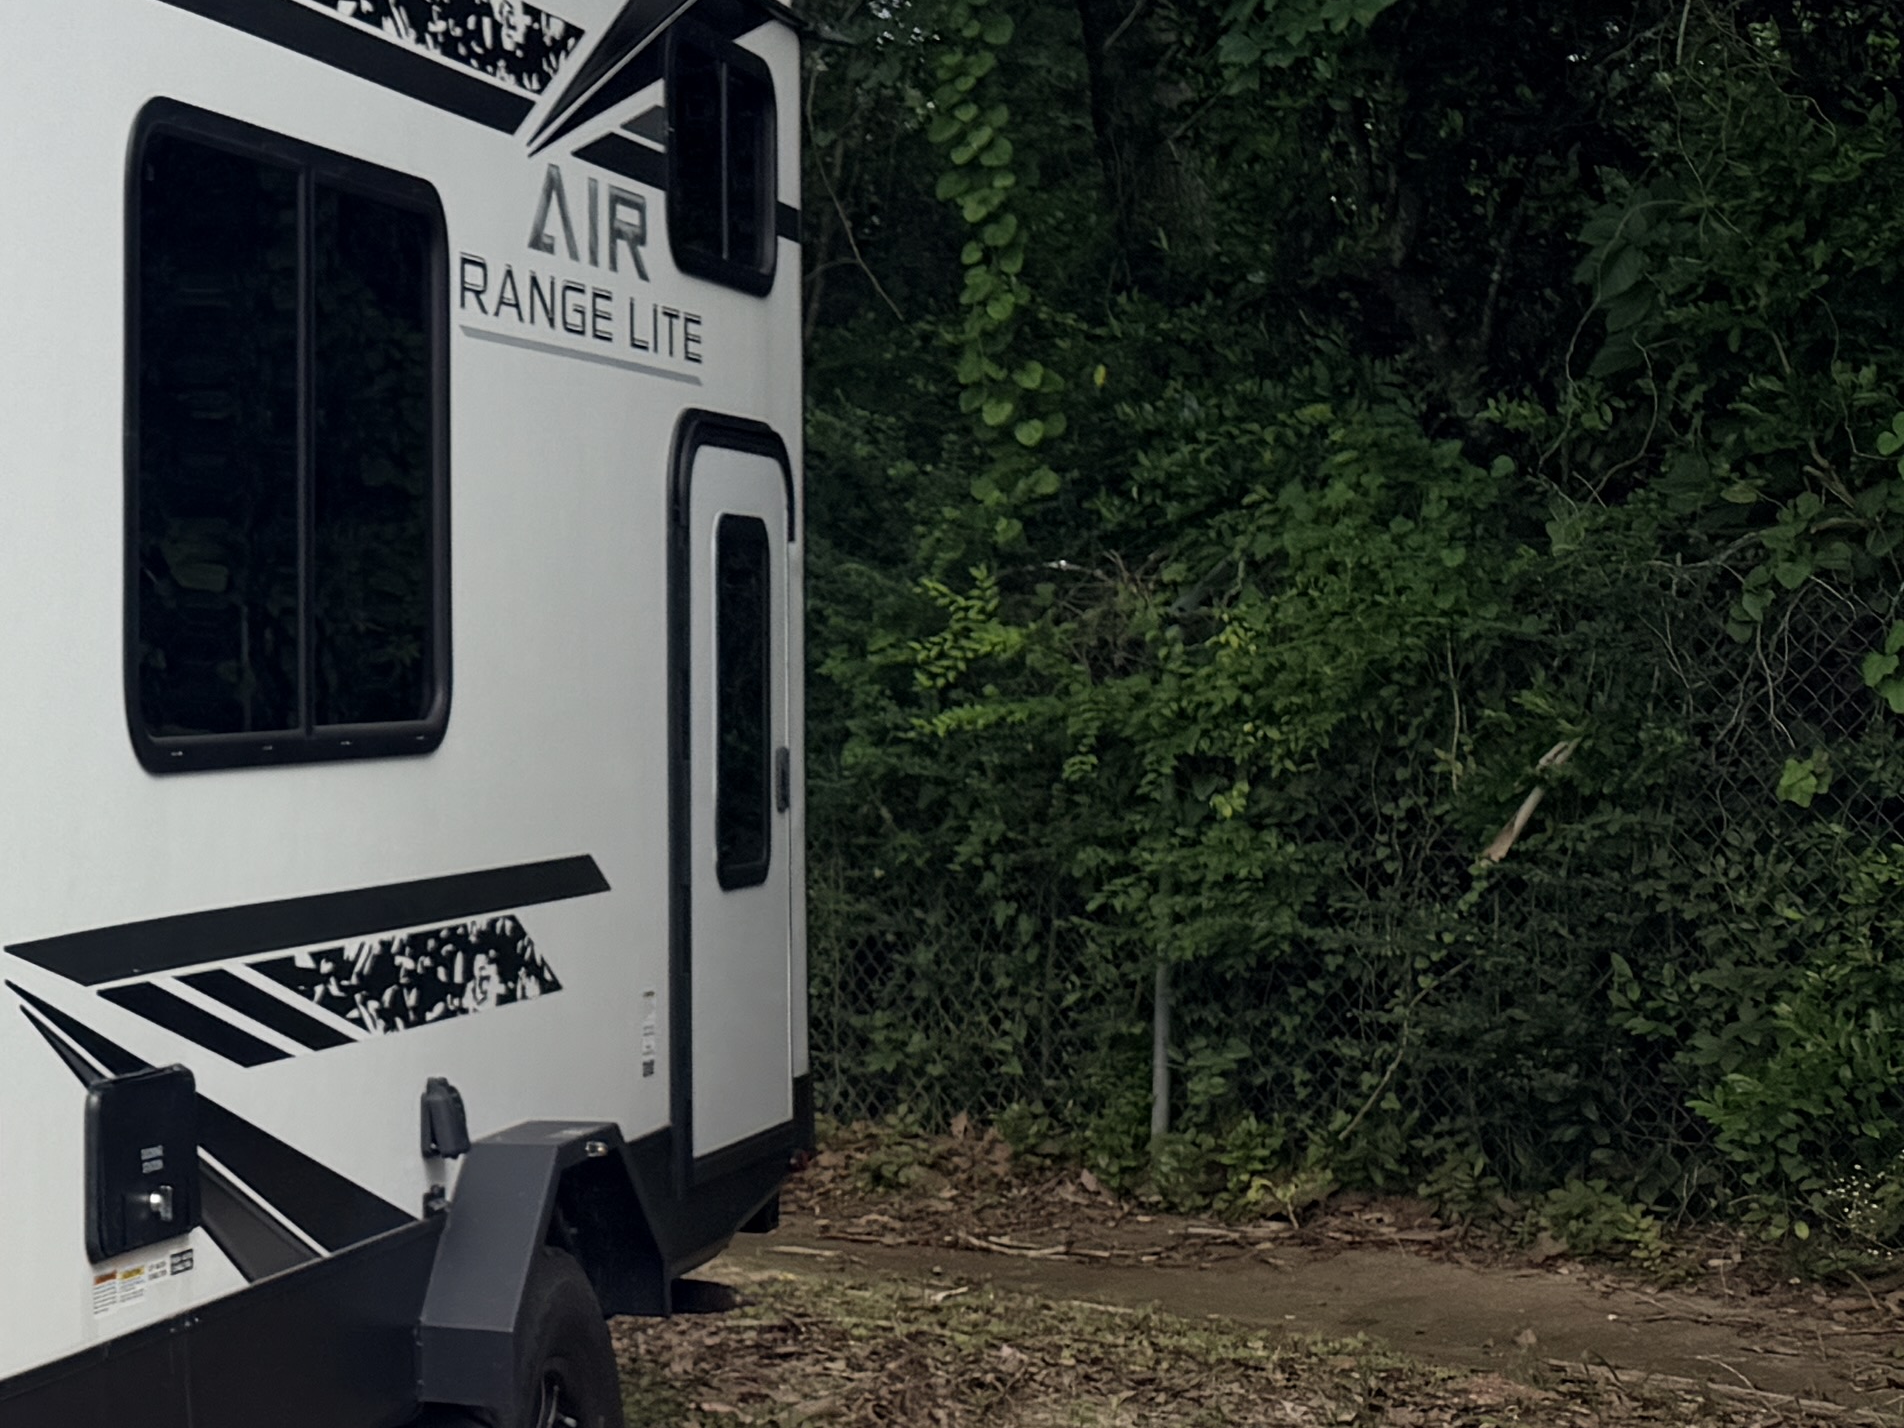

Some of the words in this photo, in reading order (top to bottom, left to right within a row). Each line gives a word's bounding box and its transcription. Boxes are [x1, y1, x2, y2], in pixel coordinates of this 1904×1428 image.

[527, 162, 650, 283] AIR
[459, 251, 613, 343] RANGE
[629, 296, 703, 364] LITE
